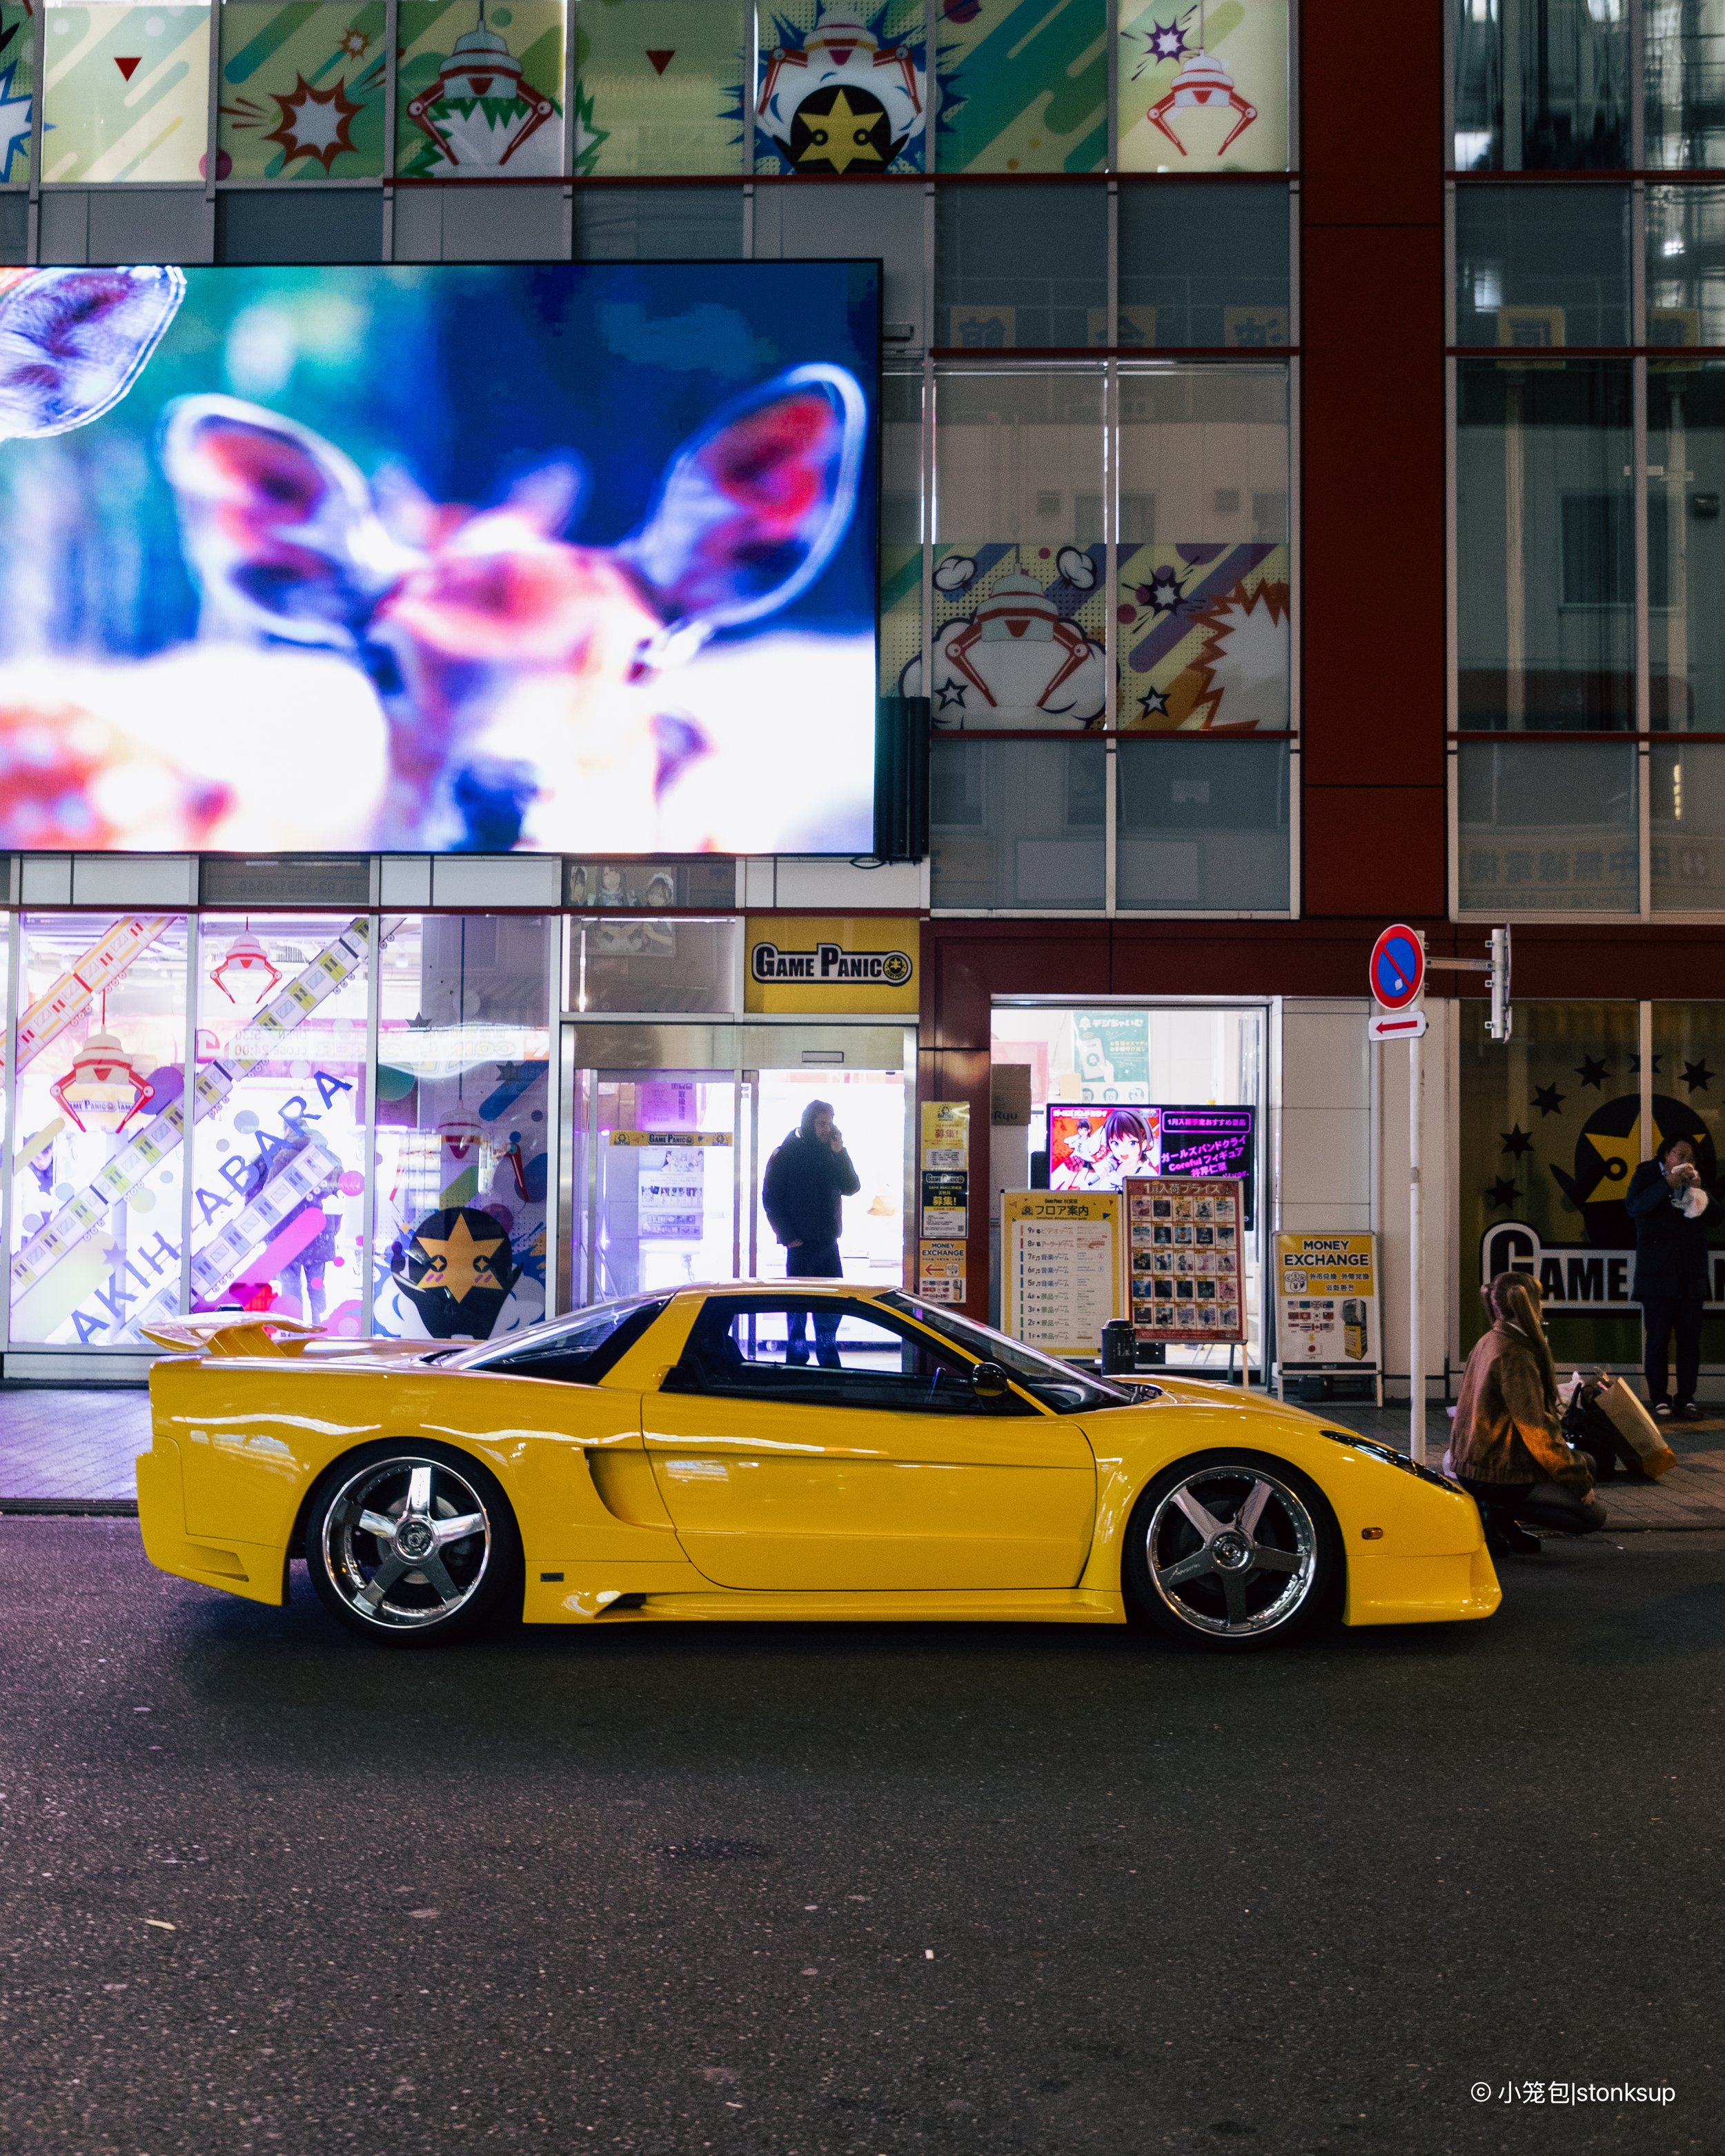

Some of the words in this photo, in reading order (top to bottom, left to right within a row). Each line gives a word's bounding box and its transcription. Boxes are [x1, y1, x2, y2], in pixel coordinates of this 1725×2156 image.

[756, 947, 814, 978] GAME
[821, 947, 881, 978] PANIC
[1161, 1136, 1246, 1163] ガールズバンドクライ
[1168, 1157, 1203, 1171] Coreful
[1203, 1147, 1244, 1165] フィギュア
[70, 1070, 353, 1344] AKIHABARA
[1035, 1205, 1089, 1216] フロア案内
[1303, 1240, 1349, 1250] MONEY
[1285, 1254, 1369, 1265] EXCHANGE
